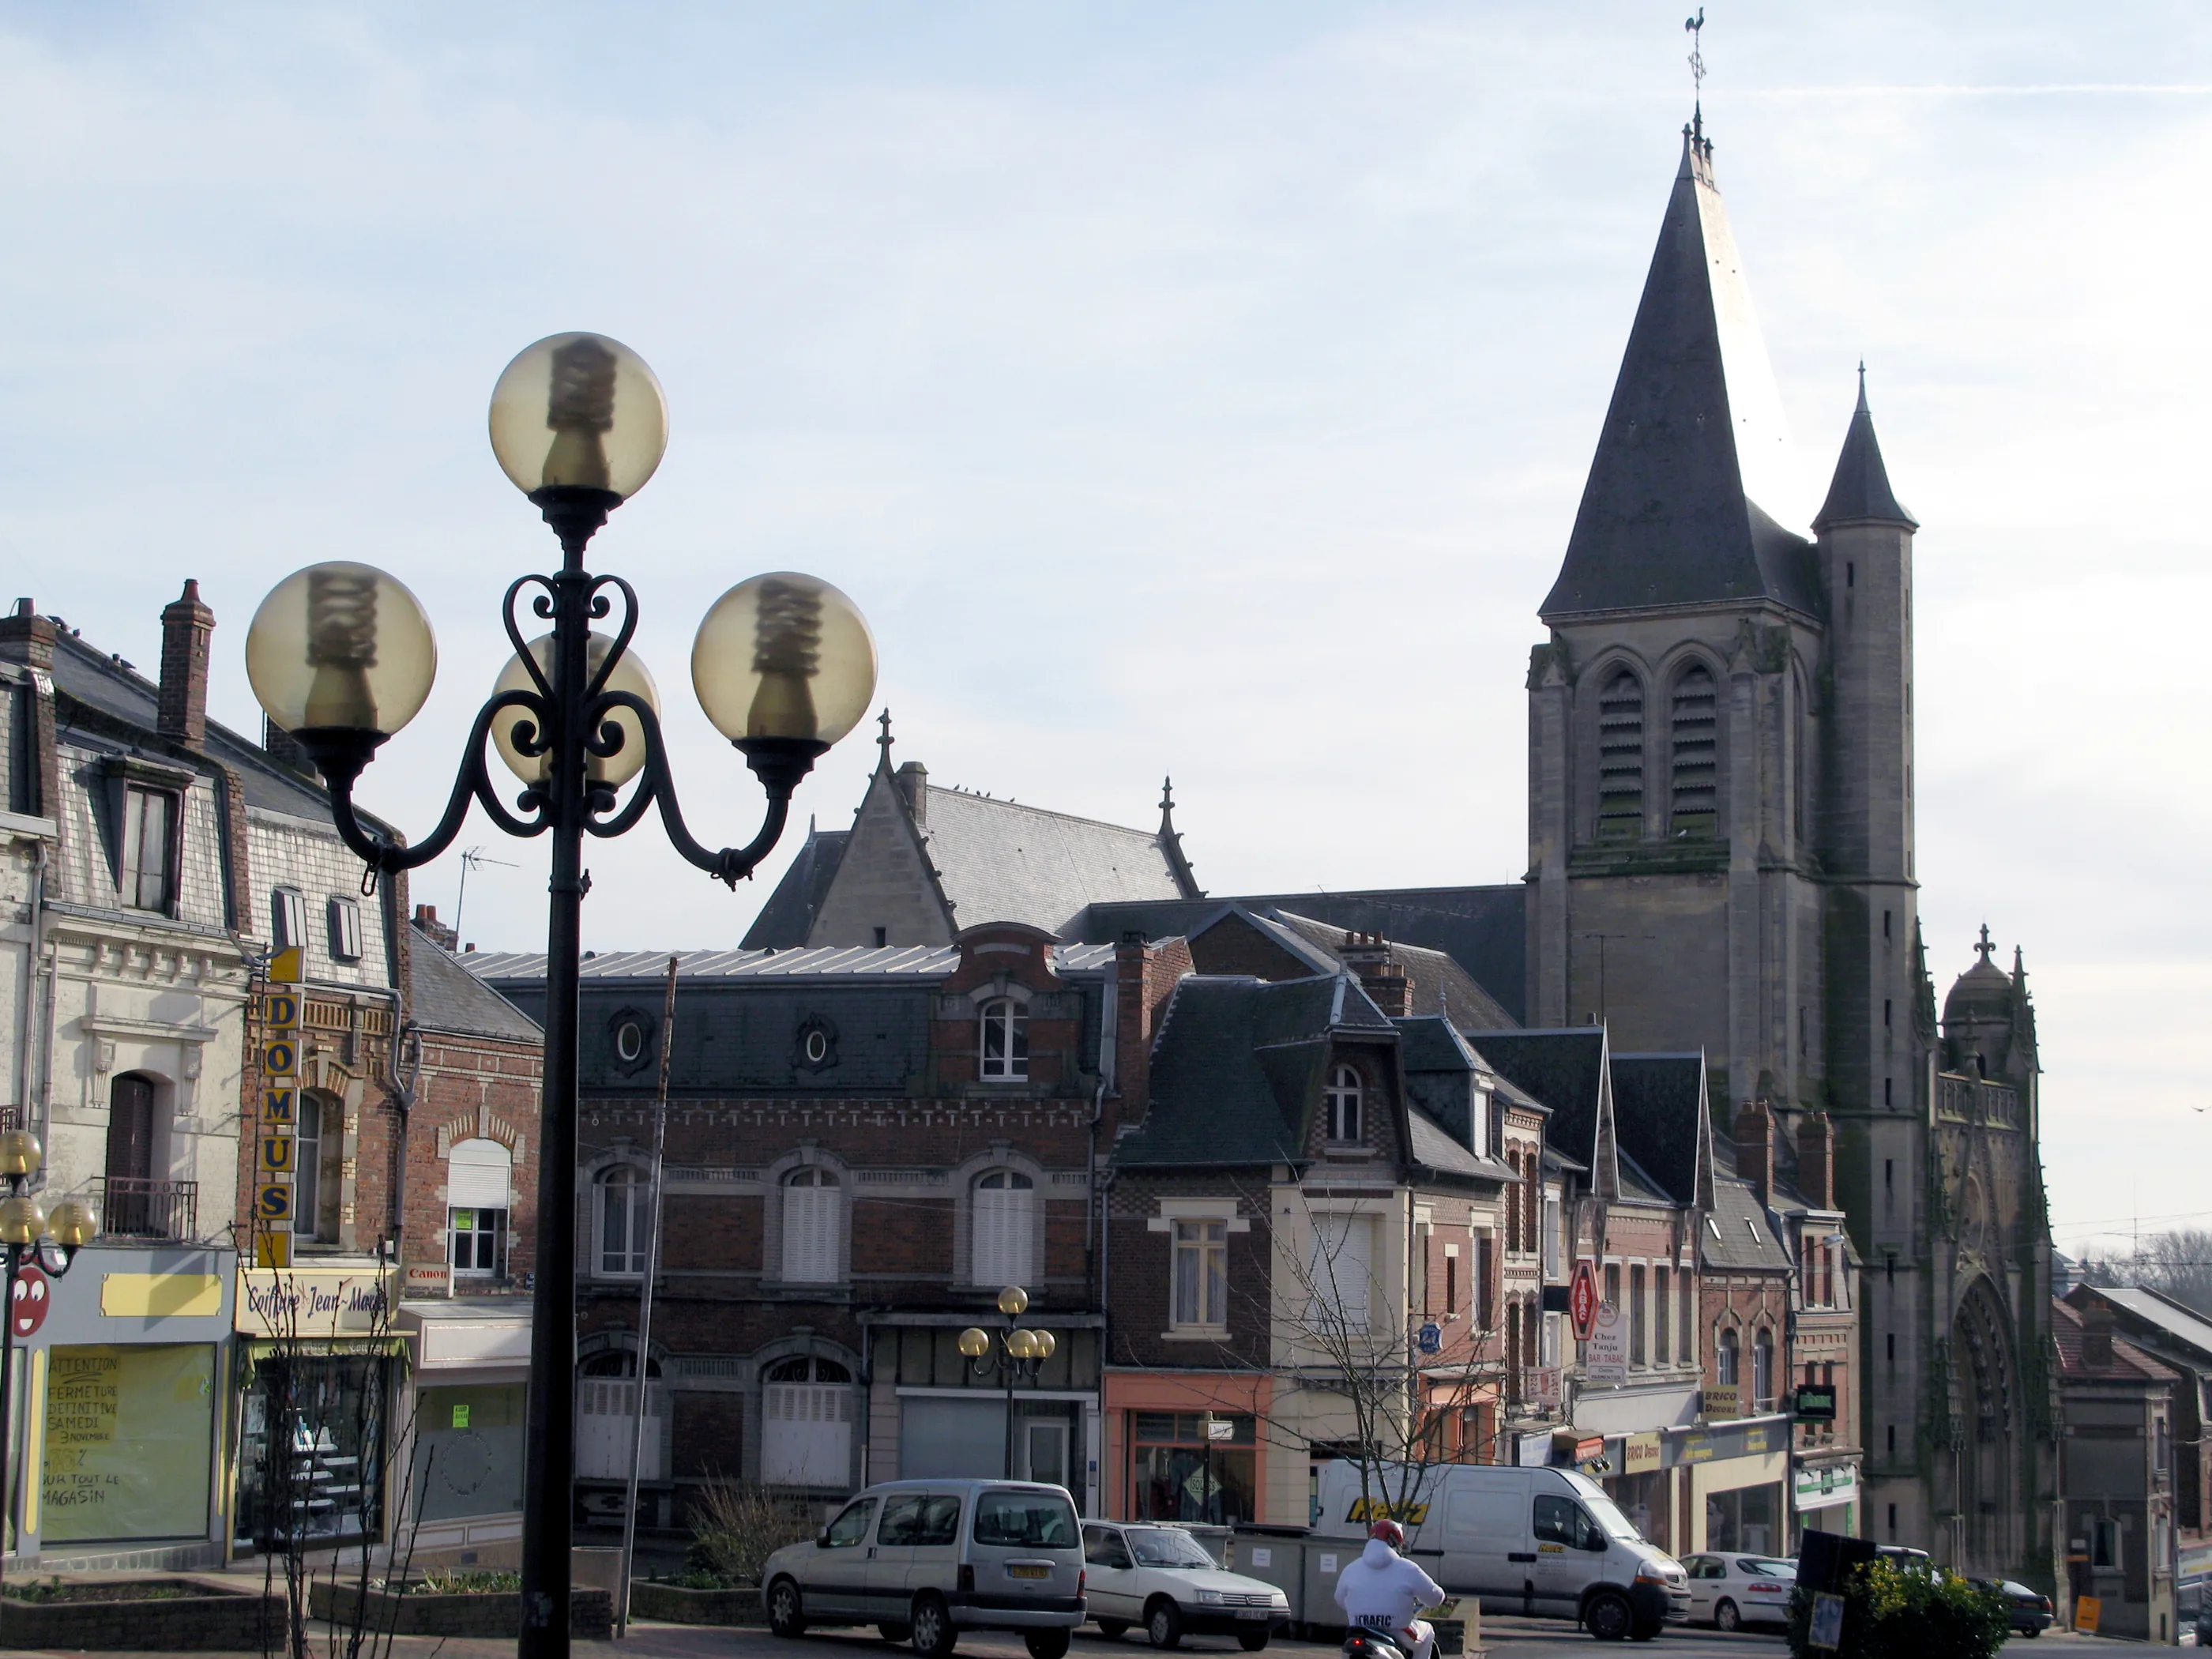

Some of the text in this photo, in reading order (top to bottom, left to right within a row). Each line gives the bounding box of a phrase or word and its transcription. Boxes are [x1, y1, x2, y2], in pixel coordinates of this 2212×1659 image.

[261, 997, 295, 1216] DOMUS
[409, 1269, 446, 1279] Canon
[1578, 1279, 1588, 1321] TABAC
[1593, 1343, 1618, 1352] Tanju
[49, 1358, 117, 1373] ATTENTION
[1705, 1391, 1736, 1401] BRICO
[47, 1416, 99, 1431] SAMEDI
[72, 1474, 100, 1484] TOUT
[105, 1474, 119, 1484] LE
